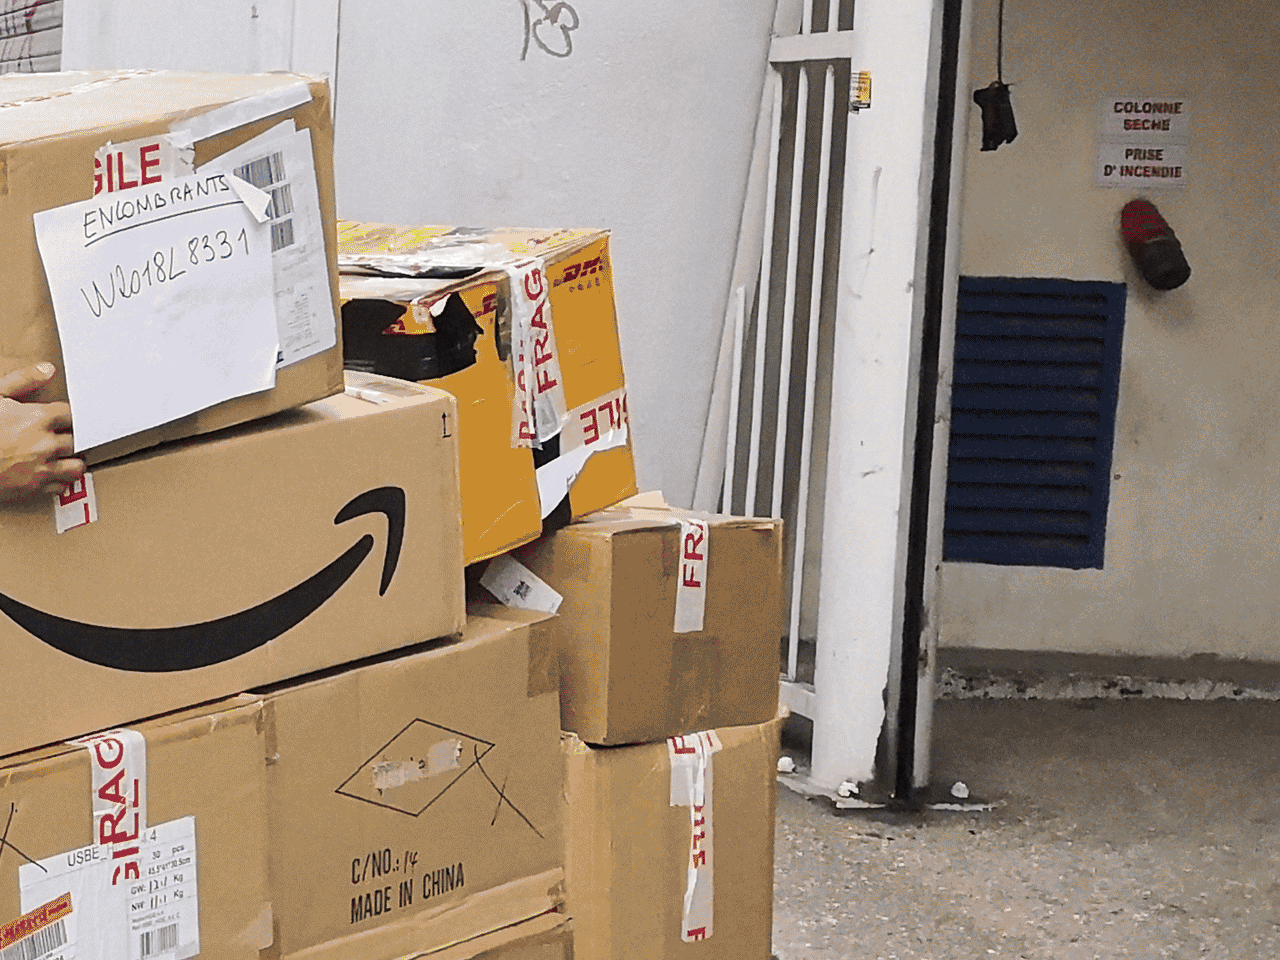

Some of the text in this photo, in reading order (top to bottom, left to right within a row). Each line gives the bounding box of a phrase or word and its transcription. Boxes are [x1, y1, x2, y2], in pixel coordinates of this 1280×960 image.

[1113, 101, 1183, 115] COLONNE
[1123, 118, 1170, 131] SECHE
[1124, 148, 1164, 161] PRISE
[1120, 165, 1183, 178] INCENDIE
[523, 267, 558, 394] FRAG
[682, 523, 704, 588] FR
[172, 845, 185, 856] pcs
[173, 873, 184, 883] Kg
[173, 889, 184, 899] Kg
[351, 862, 465, 924] MADE IN CHINA
